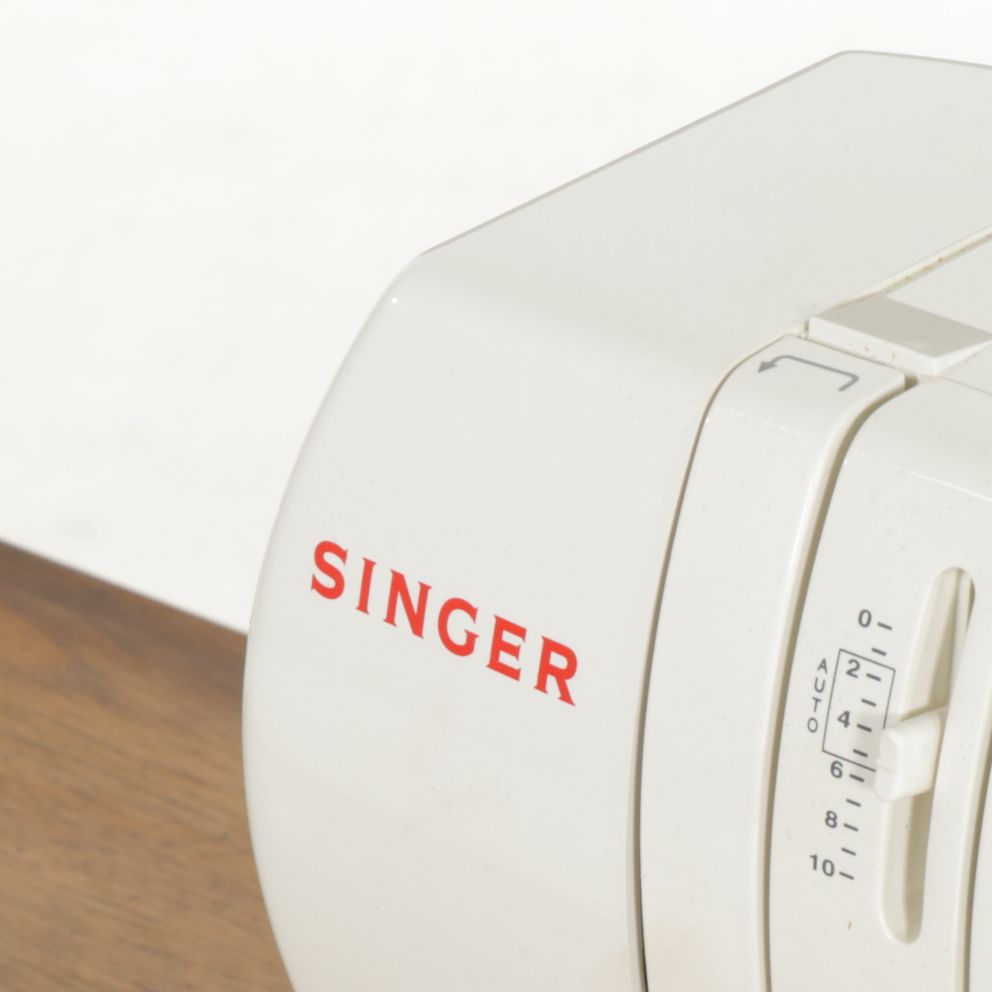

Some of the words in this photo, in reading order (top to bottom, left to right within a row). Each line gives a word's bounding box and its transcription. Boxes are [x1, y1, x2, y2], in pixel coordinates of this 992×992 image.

[311, 540, 578, 707] SINGER
[858, 609, 872, 628] 0
[846, 659, 860, 678] 2
[806, 658, 828, 733] AUTO
[837, 710, 850, 729] 4
[830, 761, 843, 779] 6
[825, 810, 838, 829] 8
[809, 854, 836, 877] 10
